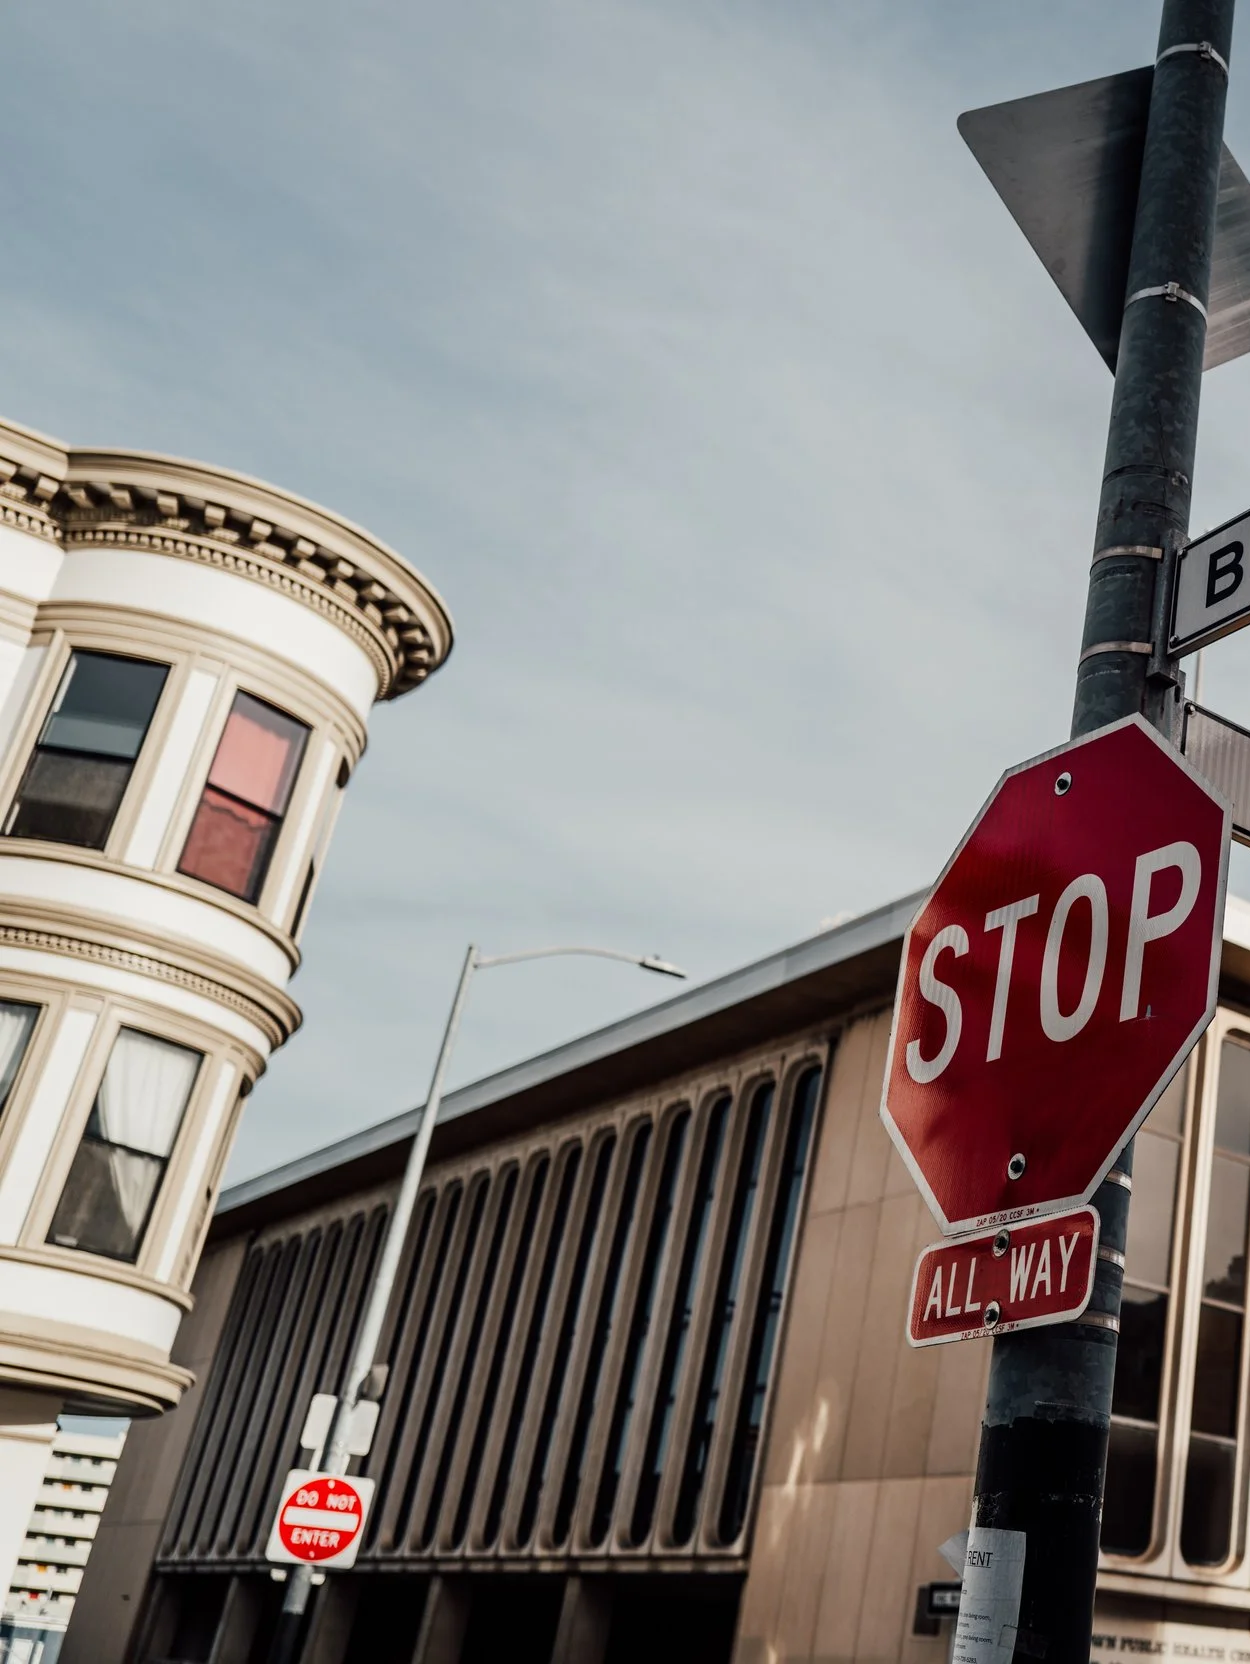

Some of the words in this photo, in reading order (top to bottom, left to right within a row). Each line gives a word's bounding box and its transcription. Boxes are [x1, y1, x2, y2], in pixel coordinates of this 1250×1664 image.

[905, 840, 1203, 1085] STOP
[976, 1217, 988, 1227] ZAP
[988, 1212, 1008, 1225] 05/20
[1009, 1209, 1024, 1220] CCSF
[1026, 1207, 1035, 1216] 3M
[922, 1257, 982, 1322] ALL
[1009, 1231, 1081, 1304] WAY
[296, 1489, 319, 1507] DO
[326, 1493, 357, 1511] NOT
[290, 1527, 341, 1548] ENTER
[967, 1550, 994, 1567] RENT
